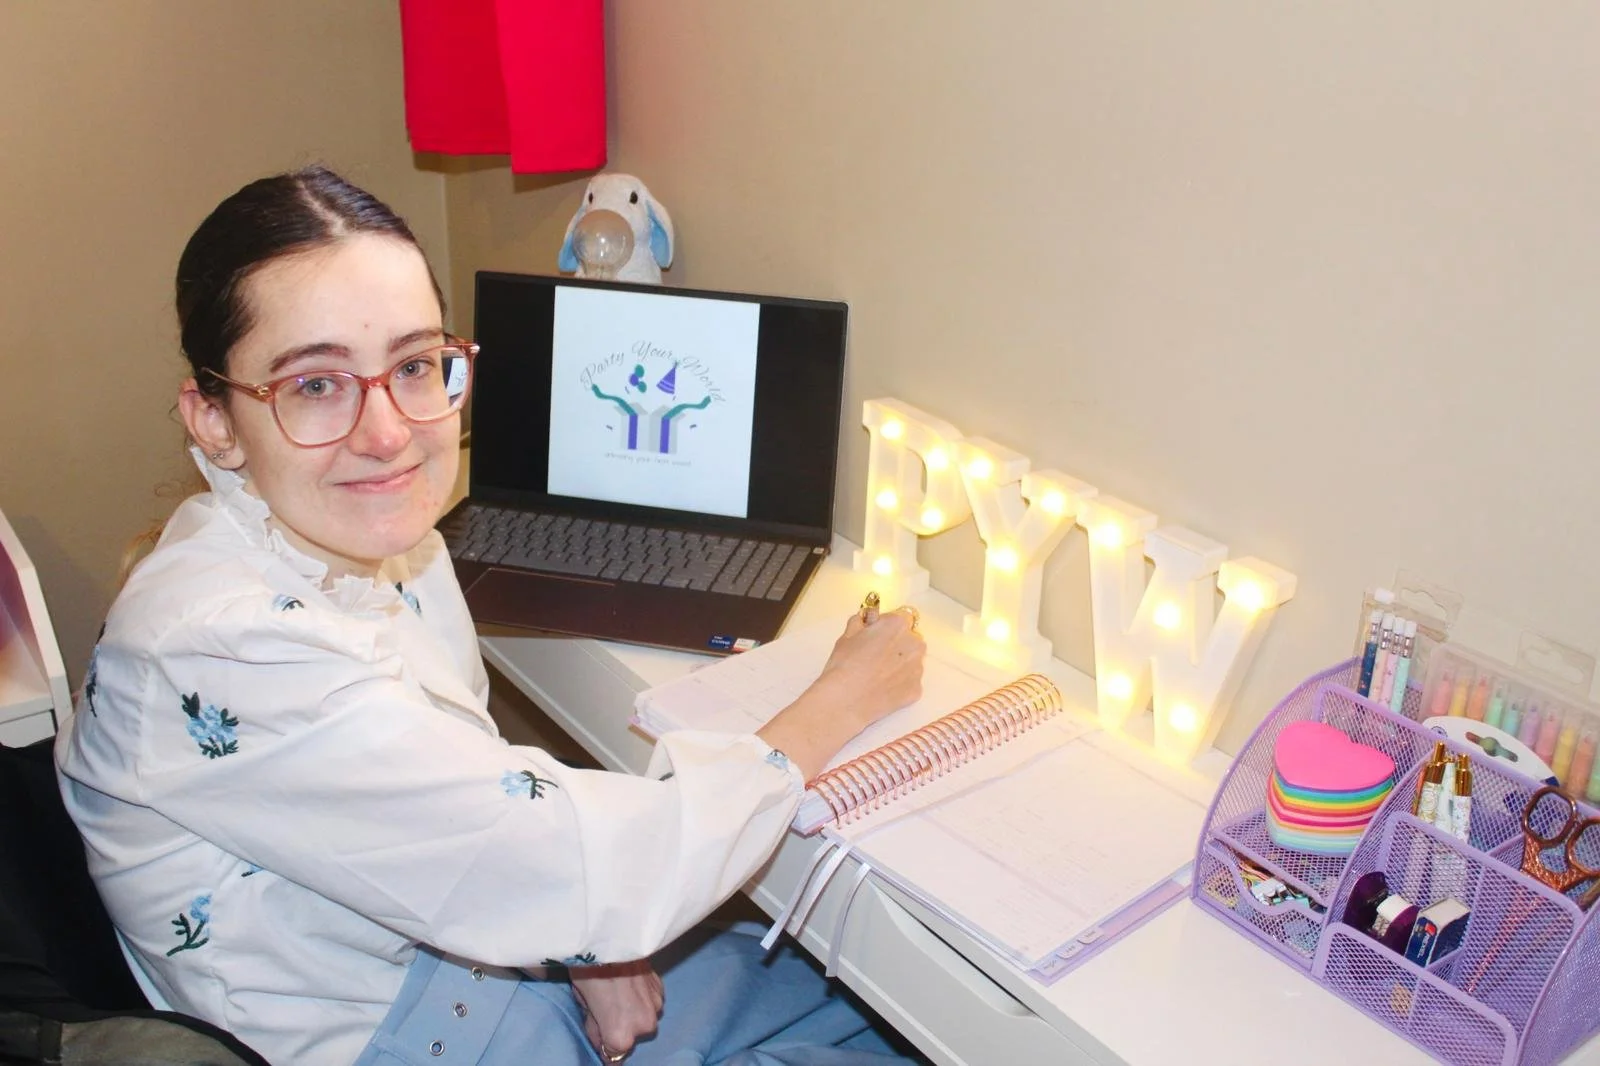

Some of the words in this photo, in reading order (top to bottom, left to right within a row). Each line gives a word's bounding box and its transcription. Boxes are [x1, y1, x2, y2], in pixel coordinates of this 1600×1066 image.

[579, 352, 625, 391] Party
[631, 340, 673, 362] Your
[682, 356, 726, 402] World
